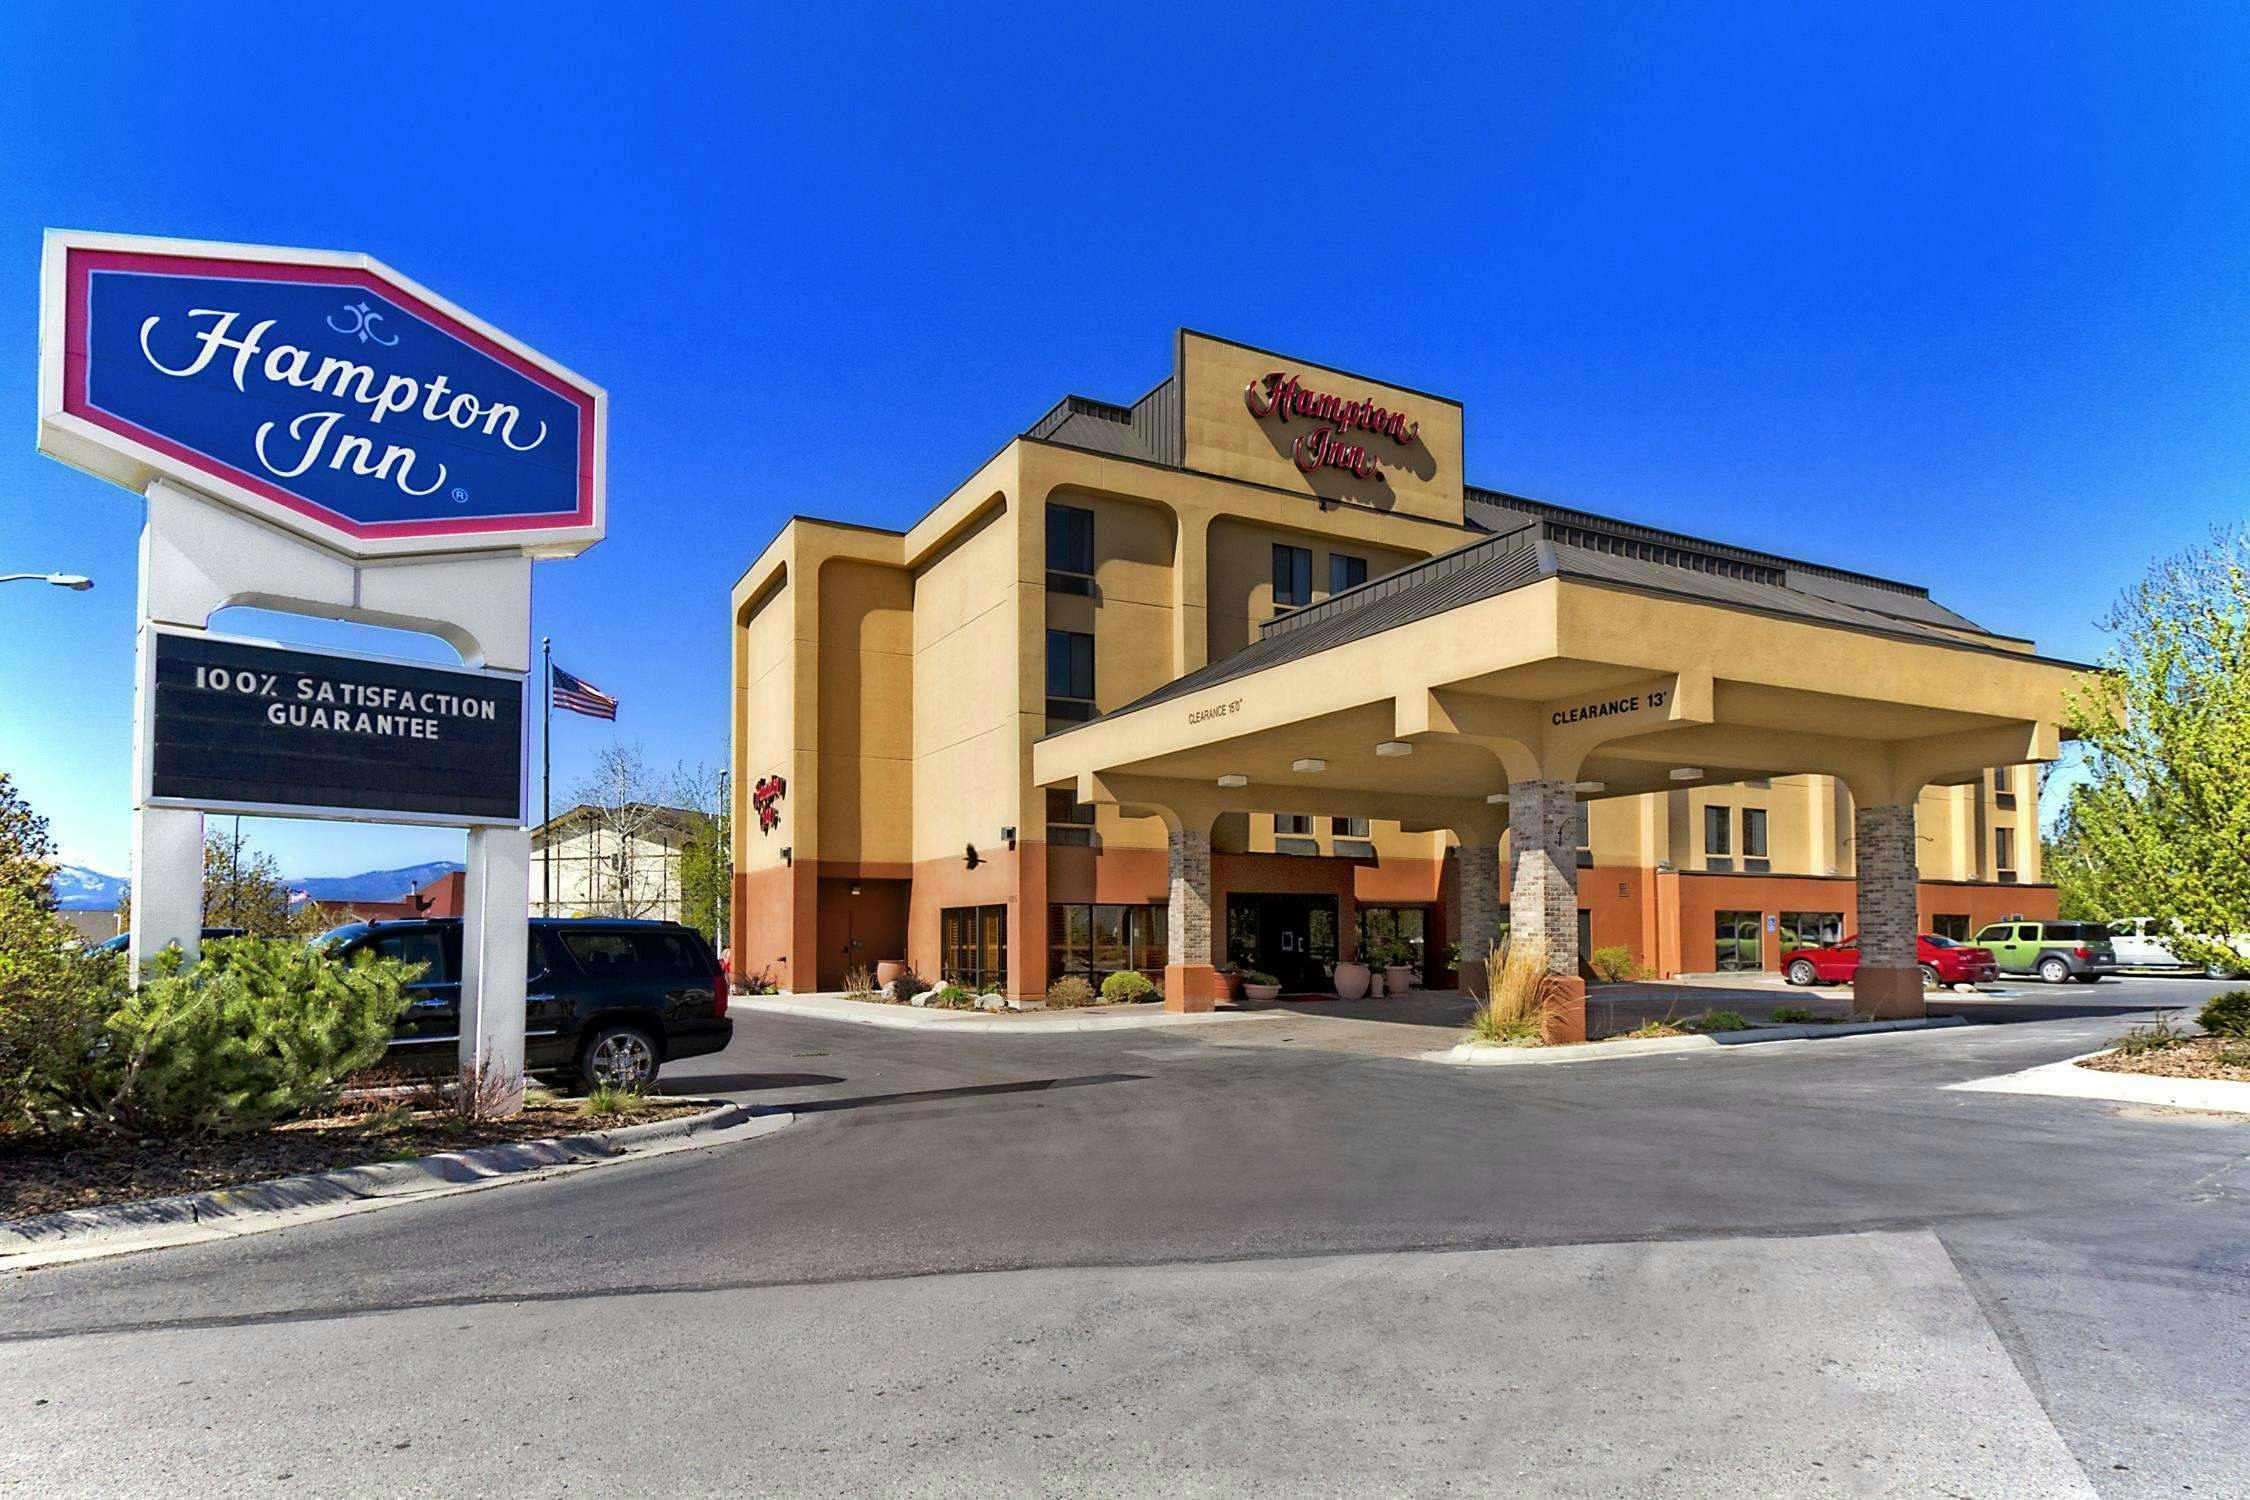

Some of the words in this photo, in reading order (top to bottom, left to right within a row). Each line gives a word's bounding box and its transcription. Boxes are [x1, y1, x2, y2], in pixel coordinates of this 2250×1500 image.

[140, 308, 547, 451] Hampton
[1245, 372, 1420, 445] Hampton
[255, 411, 447, 496] Inn
[1293, 427, 1378, 479] Inn
[196, 666, 278, 697] 100%
[297, 678, 496, 720] SATISFACTION
[1188, 704, 1227, 725] CLEARANCE
[1551, 696, 1639, 725] CLEARANCE
[1647, 691, 1667, 708] 13'
[267, 703, 439, 740] GUARANTEE
